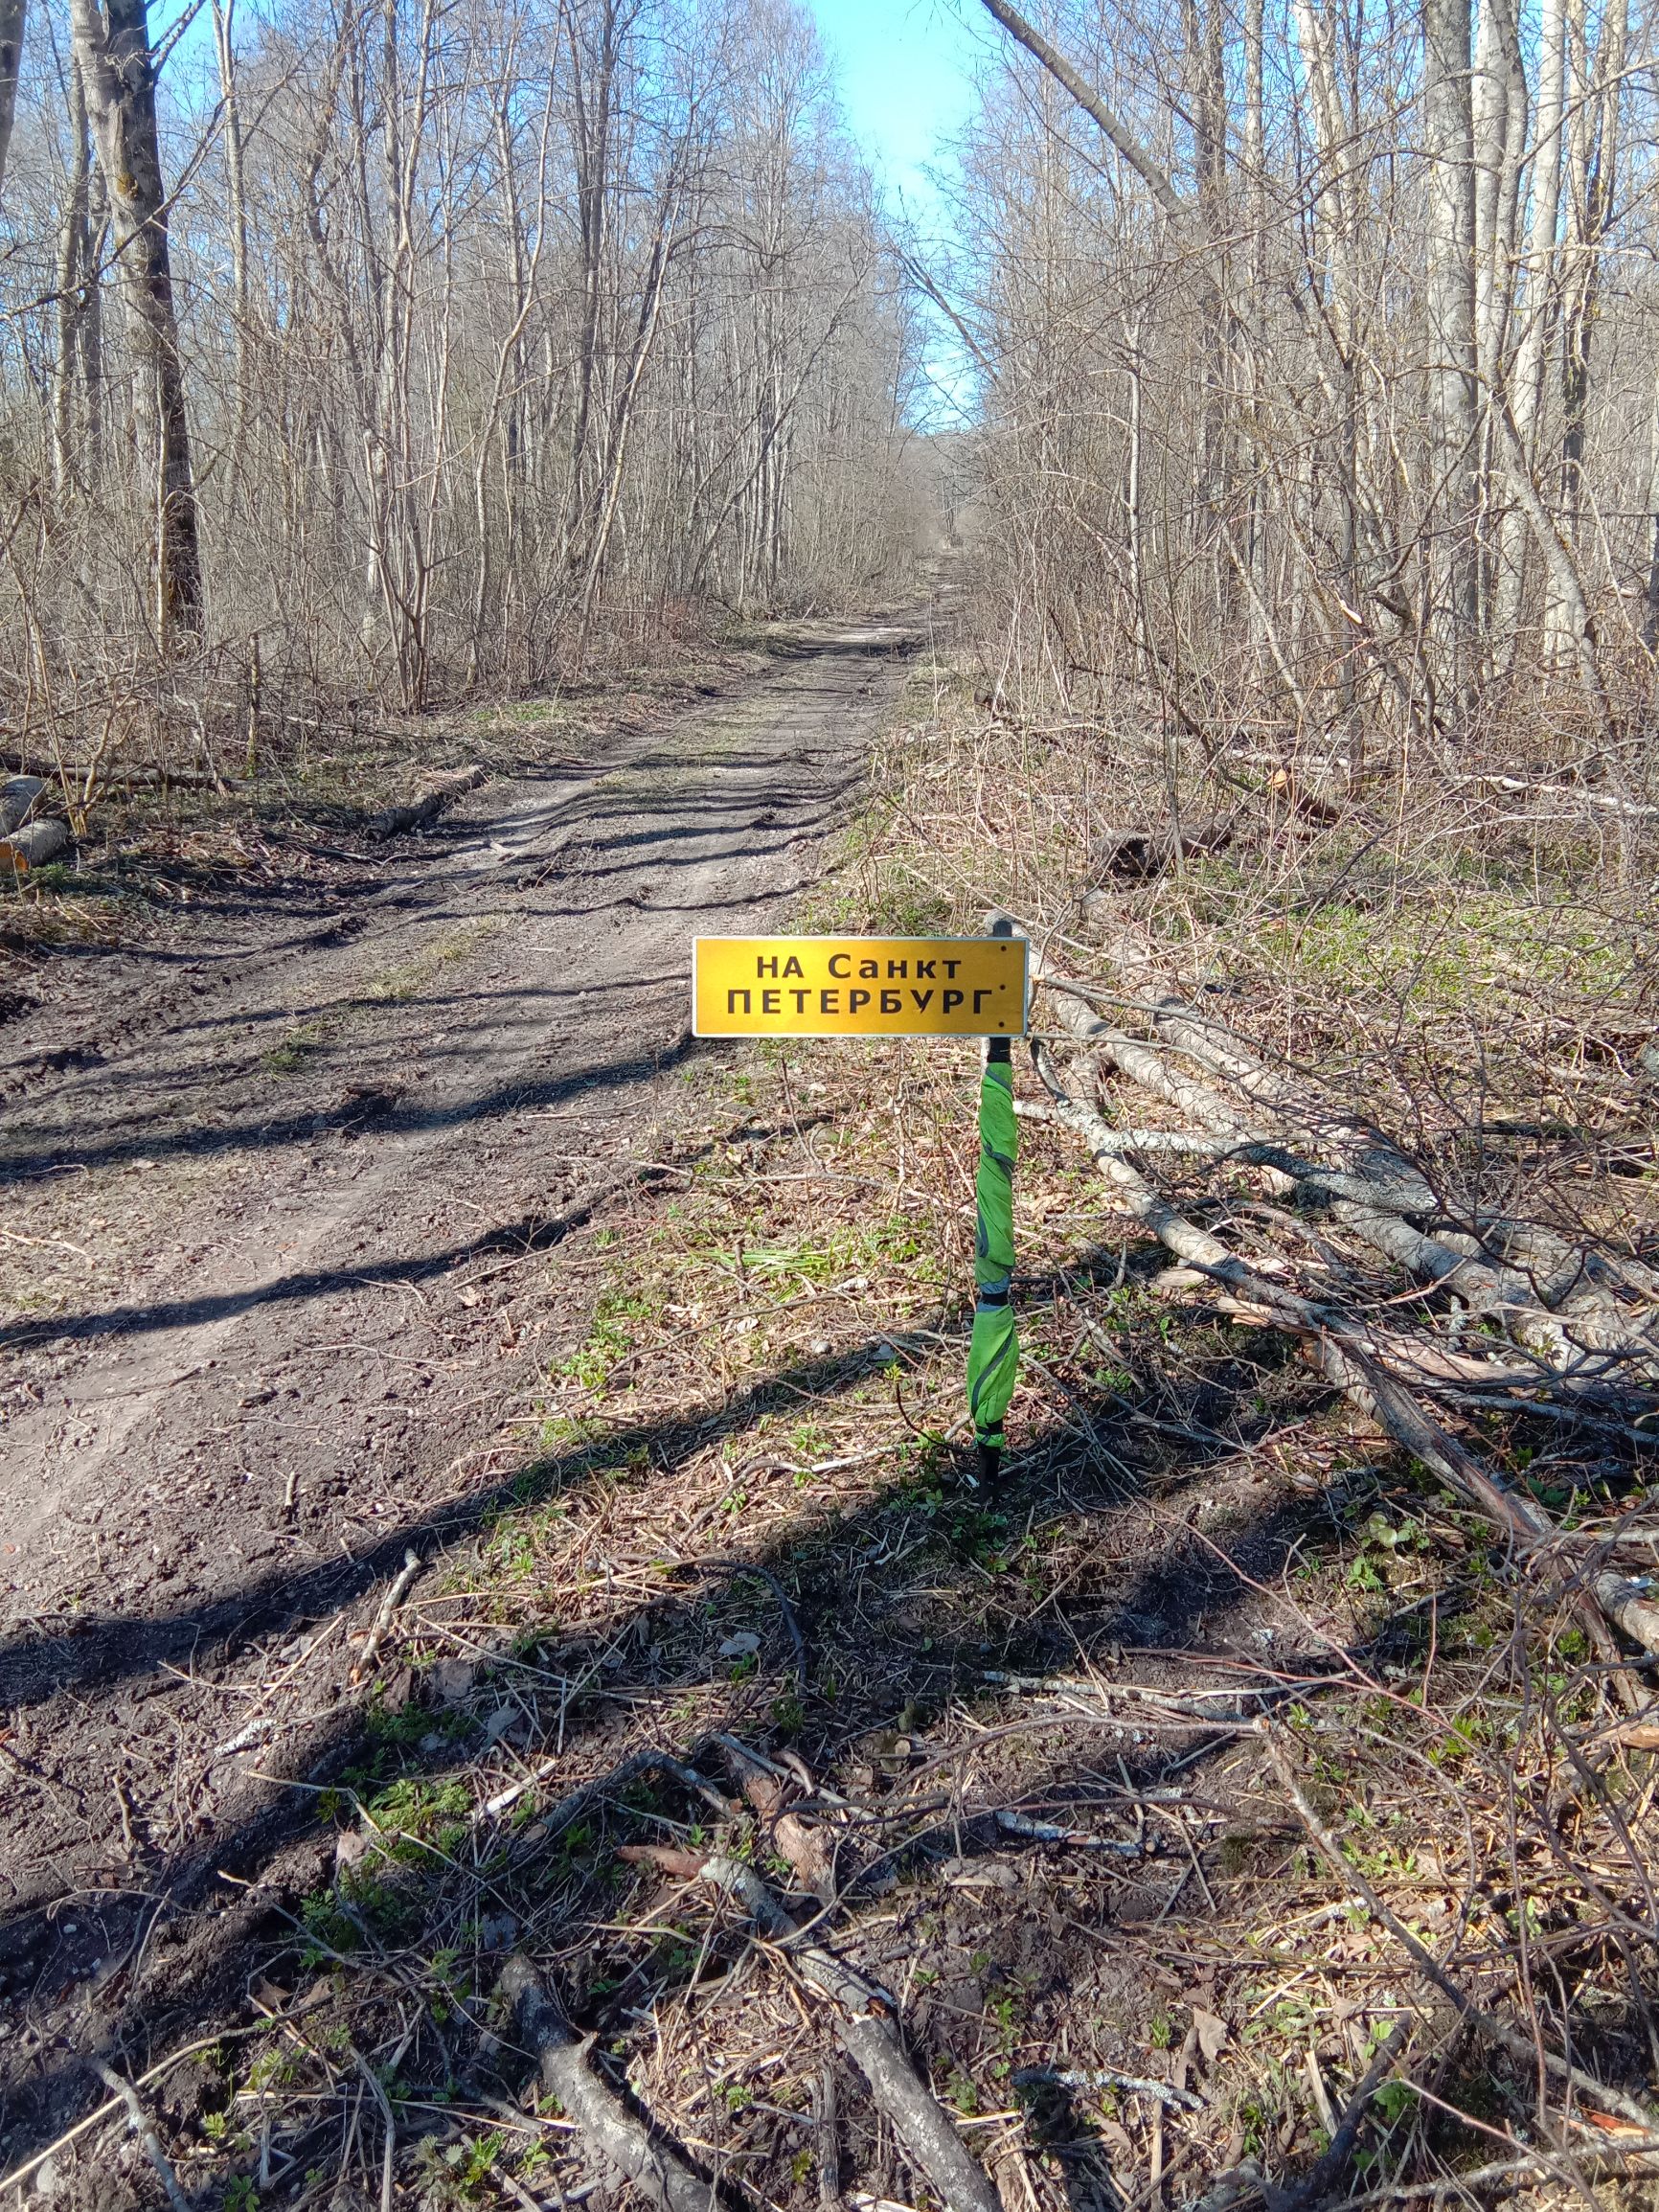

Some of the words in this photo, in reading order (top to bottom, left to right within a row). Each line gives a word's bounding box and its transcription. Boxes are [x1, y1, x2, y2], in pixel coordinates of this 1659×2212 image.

[757, 955, 805, 979] НА
[828, 953, 962, 979] Санкт
[727, 989, 993, 1015] ПЕТЕРБУРГ
